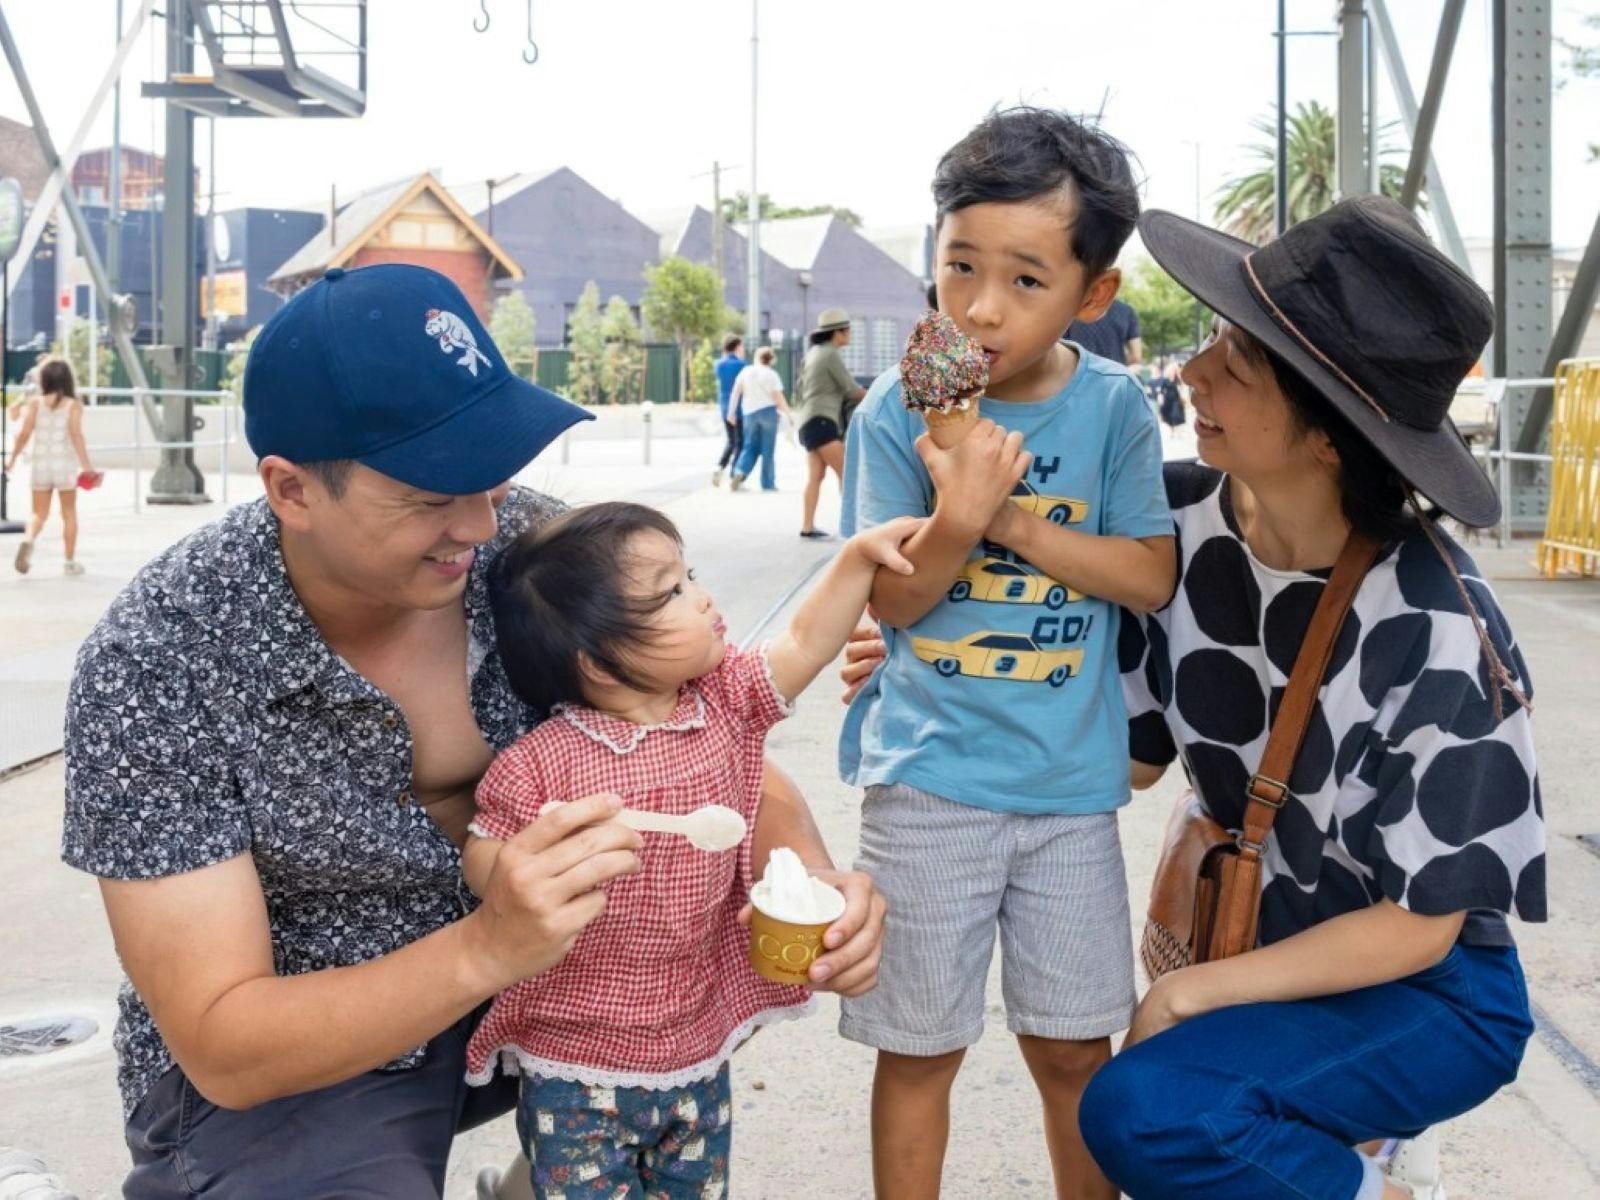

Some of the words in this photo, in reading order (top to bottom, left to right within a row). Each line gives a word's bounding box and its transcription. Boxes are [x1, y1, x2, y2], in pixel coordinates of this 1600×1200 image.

[1024, 456, 1061, 484] Y
[1006, 581, 1026, 597] 2
[1032, 615, 1093, 643] GO!
[995, 656, 1017, 672] 3
